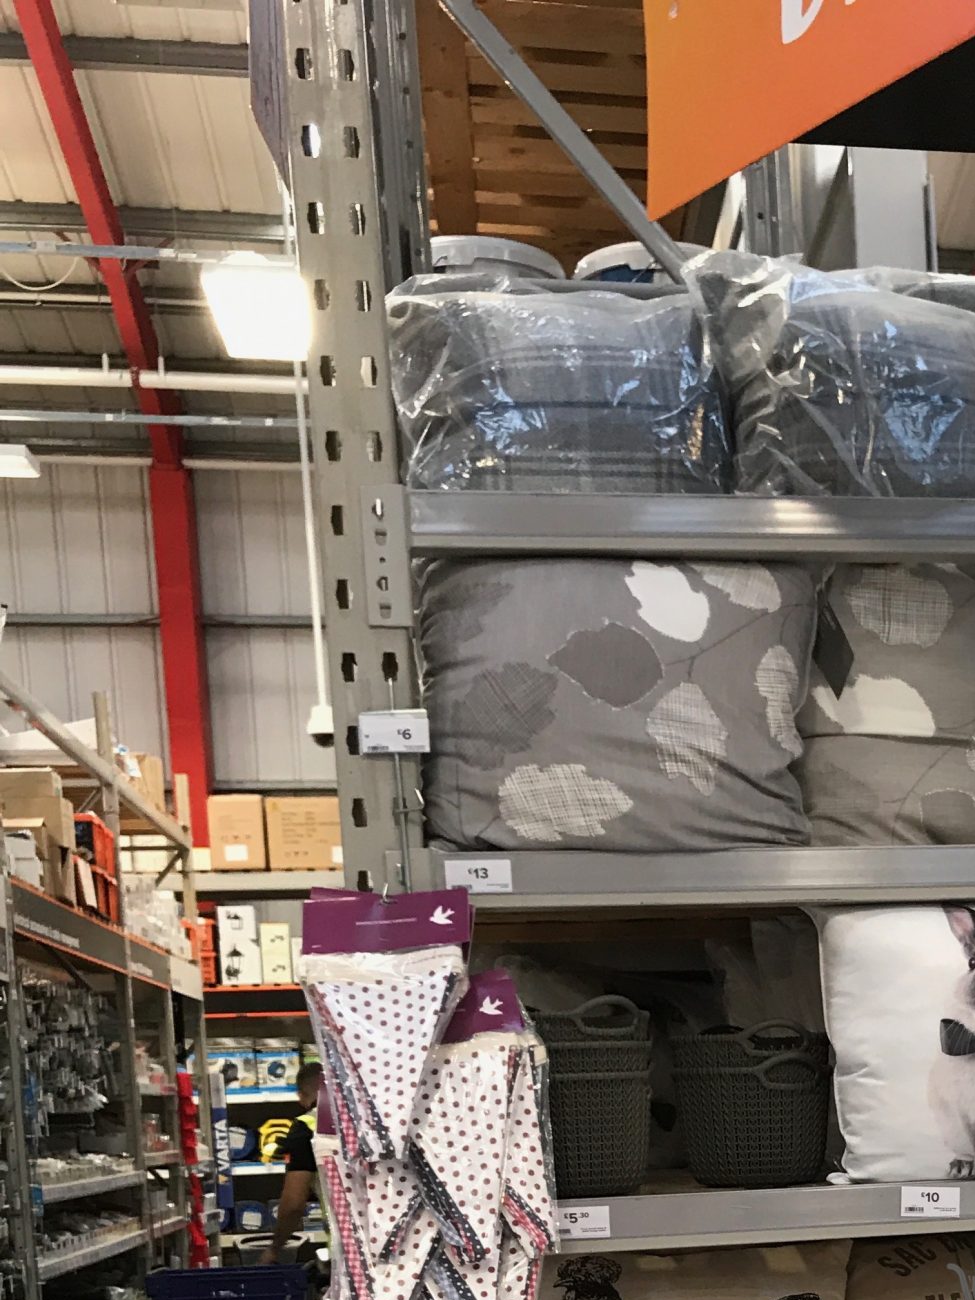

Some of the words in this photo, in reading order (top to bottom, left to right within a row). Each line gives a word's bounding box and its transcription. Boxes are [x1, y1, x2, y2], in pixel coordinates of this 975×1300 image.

[397, 729, 412, 740] £6
[468, 867, 489, 879] £13
[214, 1119, 230, 1171] VARTA
[921, 1192, 939, 1202] £10
[878, 1240, 936, 1277] SAC
